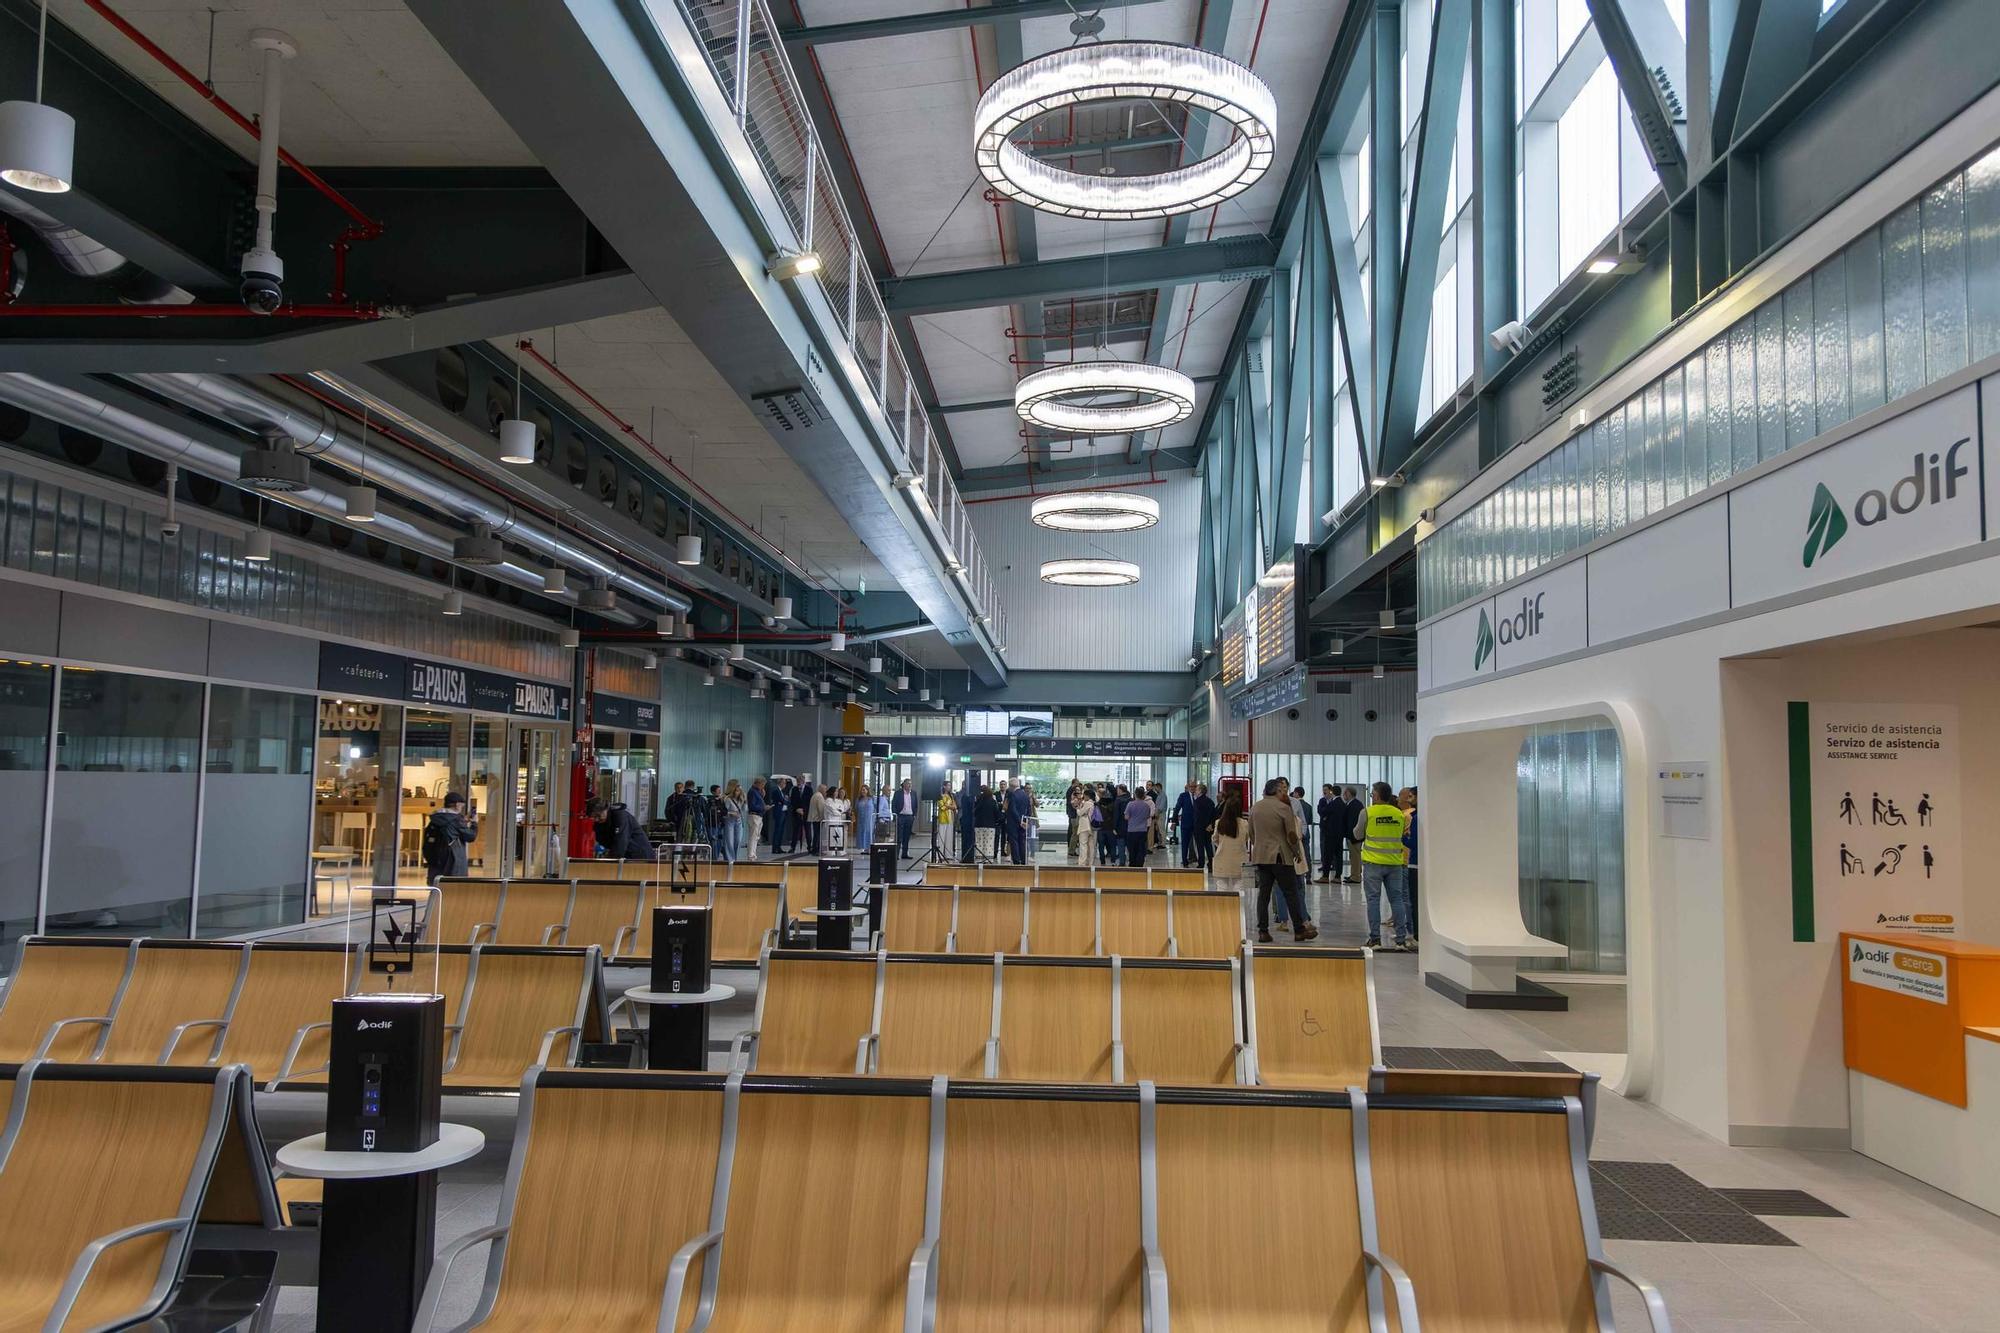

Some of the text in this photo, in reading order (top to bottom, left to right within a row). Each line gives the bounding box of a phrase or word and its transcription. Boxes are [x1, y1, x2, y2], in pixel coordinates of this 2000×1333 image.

[1854, 437, 1970, 526] adif
[1498, 592, 1545, 646] adif
[412, 666, 467, 704] LA PAUSA
[516, 684, 556, 716] LA PAUSA
[1826, 723, 1942, 734] Servicio de asistencia
[1826, 738, 1940, 749] Servizo de asistencia
[1828, 752, 1868, 760] ASSISTANCE
[1865, 950, 1934, 972] adif acerca
